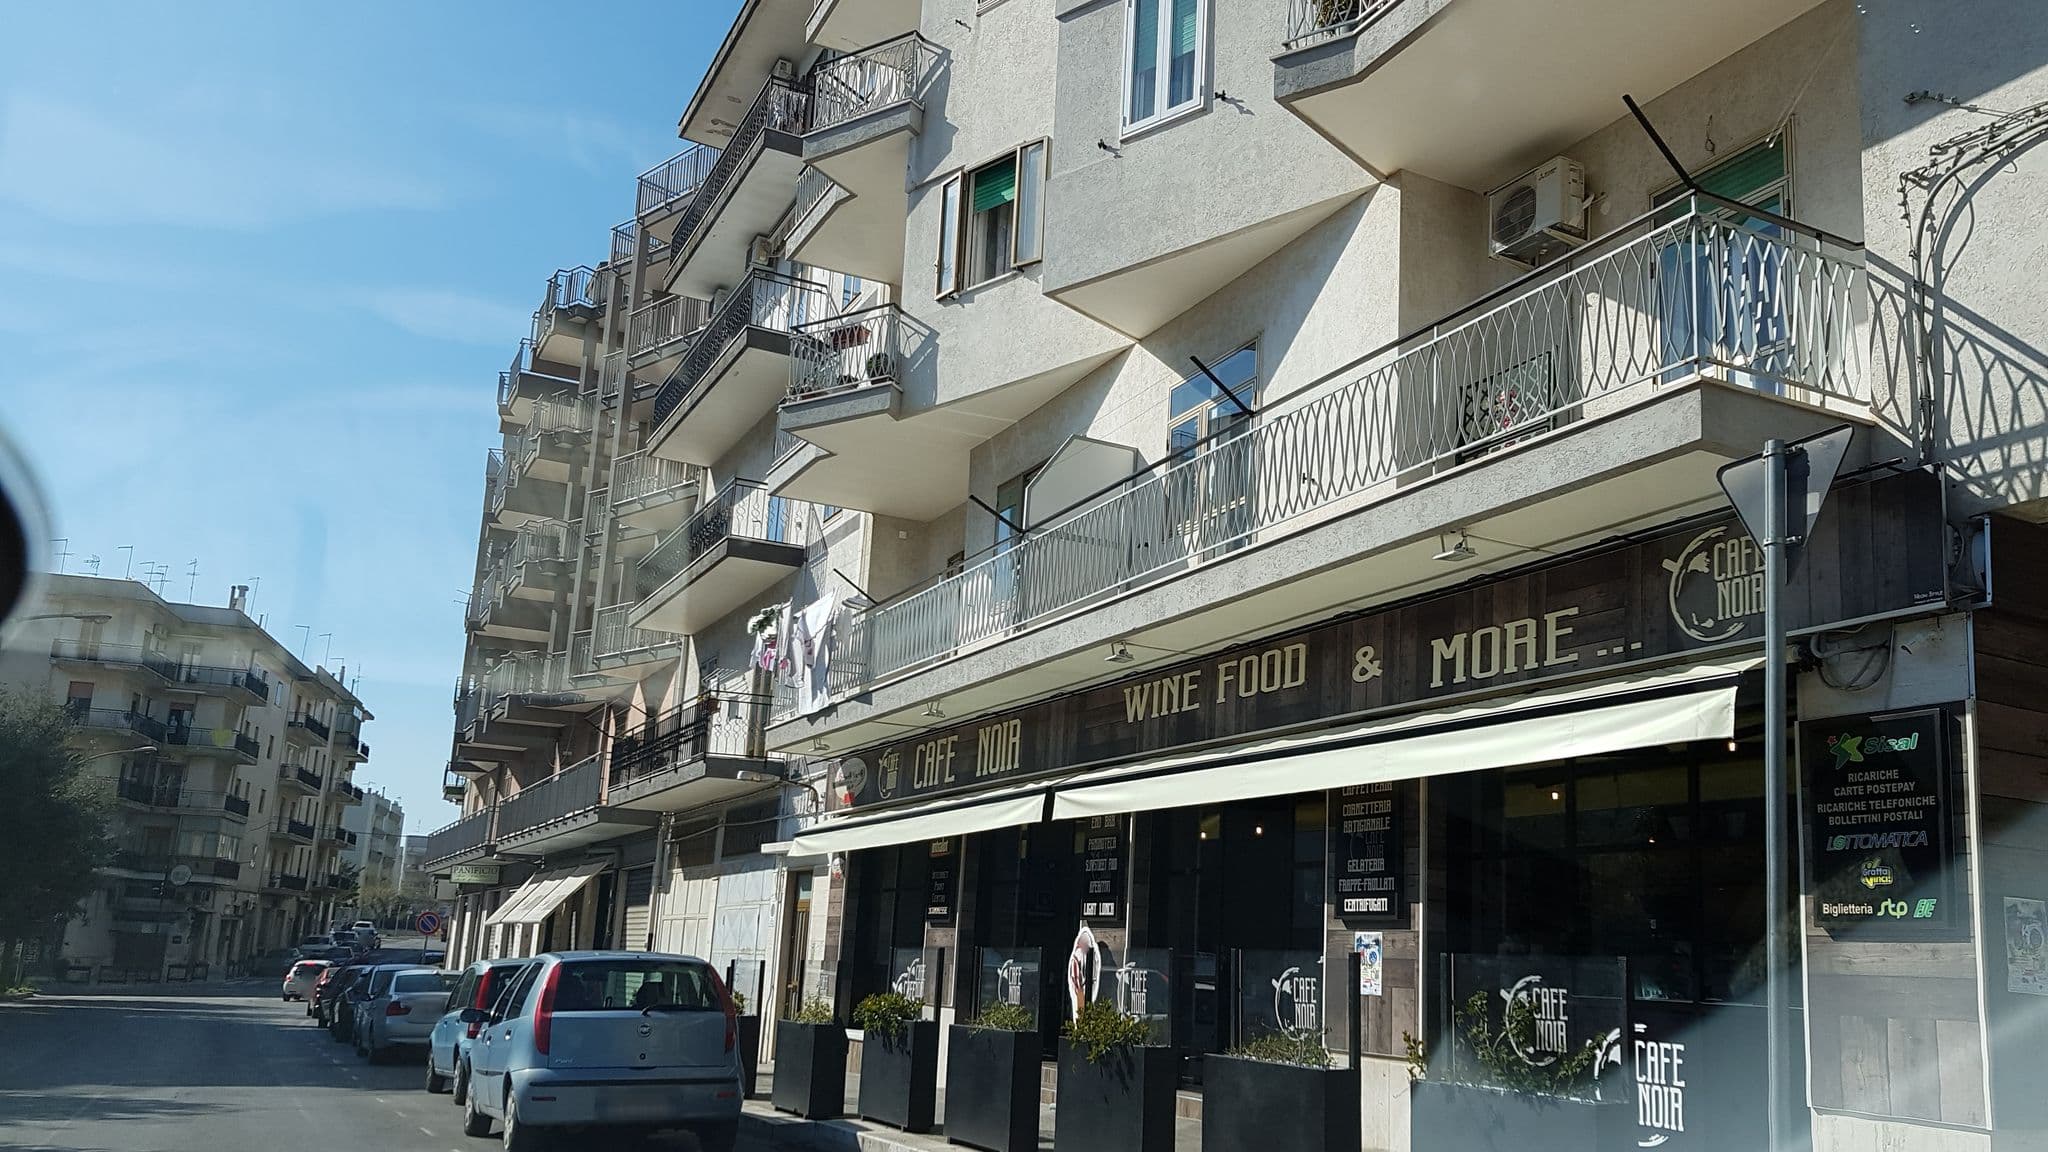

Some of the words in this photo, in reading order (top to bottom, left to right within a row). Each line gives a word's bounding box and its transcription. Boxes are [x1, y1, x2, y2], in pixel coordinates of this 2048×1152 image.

[1717, 572, 1767, 620] NOIR
[1124, 670, 1201, 723] WINE
[1216, 643, 1307, 703] FOOD
[1352, 645, 1383, 683] &
[913, 735, 959, 789] CAFE
[976, 718, 1022, 777] NOIR
[1863, 732, 1919, 754] Sisal
[1848, 769, 1899, 782] RICARICHE
[1834, 785, 1865, 797] CARTE
[1866, 781, 1916, 794] POSTEPAY
[1817, 801, 1867, 813] RICARICHE
[1868, 795, 1936, 809] TELEFONICHE
[1828, 815, 1881, 826] BOLLETTINI
[1883, 810, 1923, 822] POSTALI
[1826, 830, 1928, 851] LOTTOMATICA
[453, 865, 497, 875] PANIFICIO
[1347, 858, 1385, 873] GELATERIA
[1343, 897, 1388, 912] CENTRIFUGATI
[1822, 903, 1873, 917] Biglietteria
[1876, 898, 1908, 919] stp
[1130, 970, 1148, 993] CAFE
[1293, 977, 1317, 1004] CAFE
[1130, 992, 1147, 1015] NOIR
[1532, 987, 1568, 1021] CAFE
[1295, 1003, 1316, 1029] NOIR
[1535, 1019, 1568, 1053] NOIR
[1634, 1040, 1686, 1088] CAFE
[1637, 1083, 1684, 1132] NOIR
